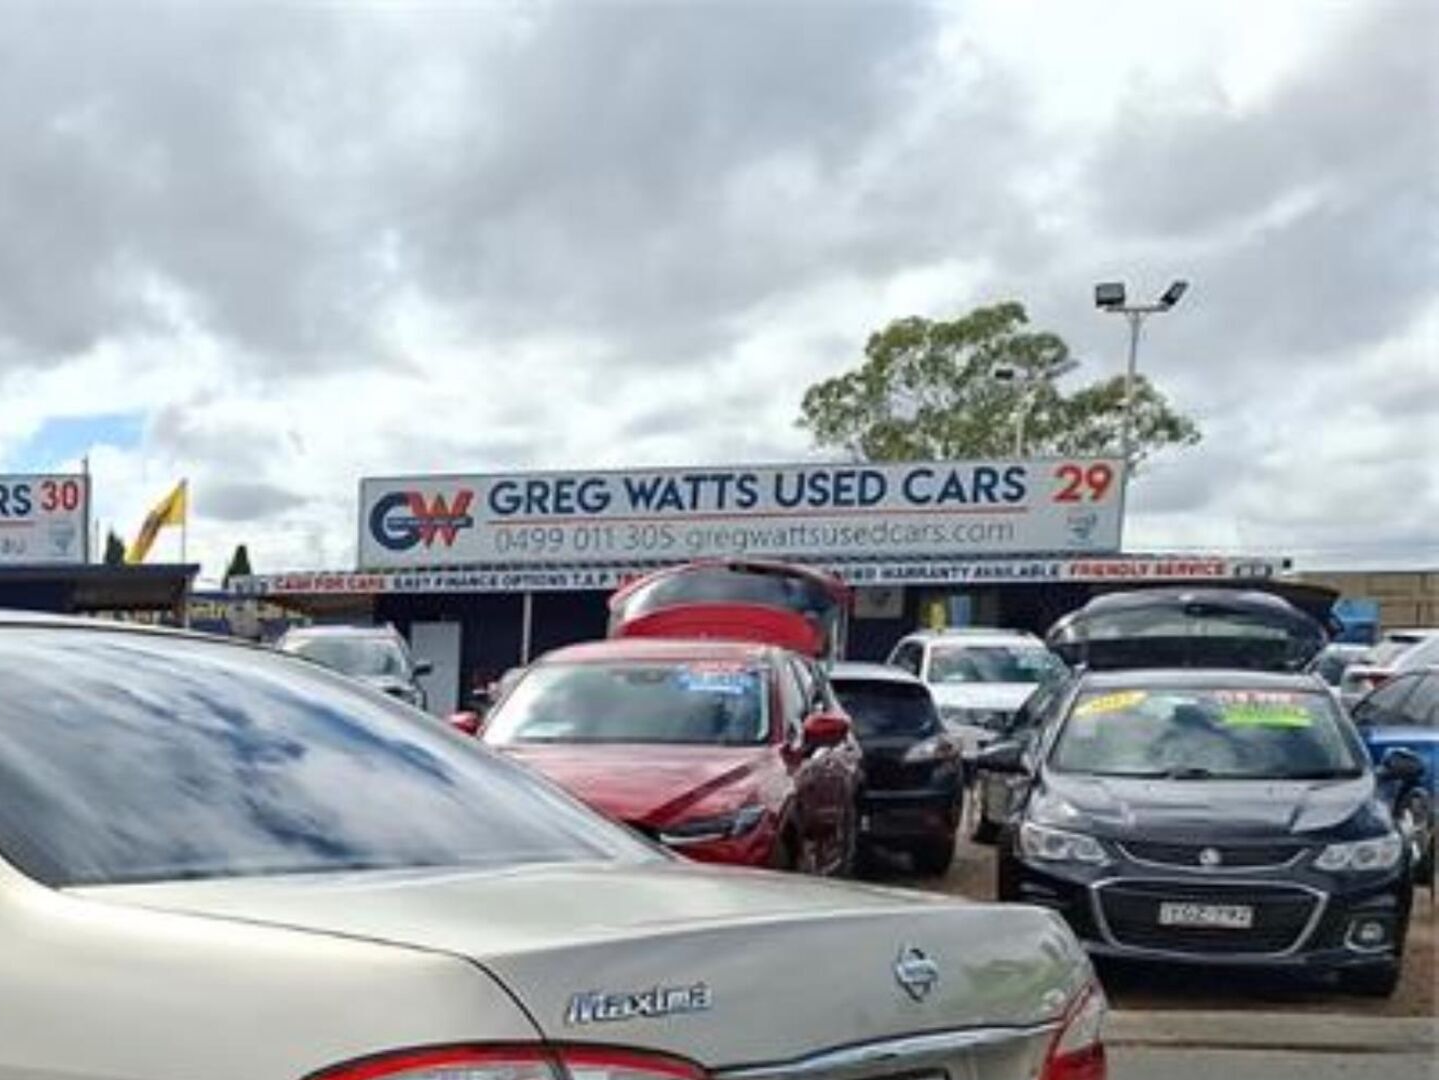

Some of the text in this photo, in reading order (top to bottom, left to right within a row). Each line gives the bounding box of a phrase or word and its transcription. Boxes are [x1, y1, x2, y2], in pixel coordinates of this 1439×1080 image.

[40, 480, 79, 512] 30
[488, 464, 1113, 514] GREG WATTS USED CARS 29
[494, 517, 1015, 552] 0499 011 305 gregwattsusedcars.com
[433, 573, 497, 588] FINANCE
[502, 573, 568, 587] OPTIONS
[882, 566, 969, 580] WARRANTY
[972, 564, 1058, 579] AVAILABLE
[1069, 559, 1226, 577] FRIENDLY SERVICE
[314, 574, 345, 589] FOR
[348, 573, 385, 589] CARS
[565, 984, 712, 1024] Maxima
